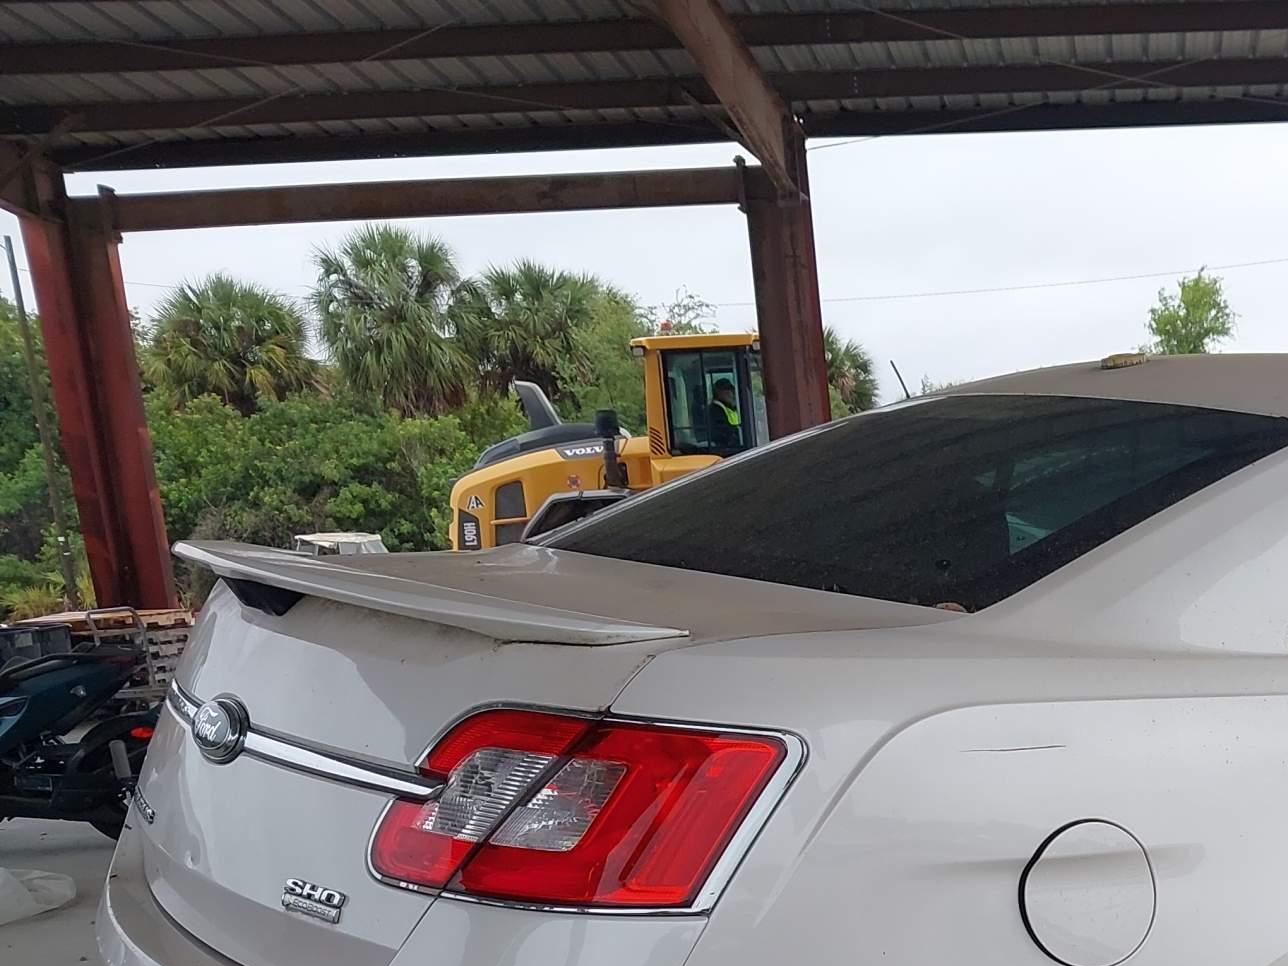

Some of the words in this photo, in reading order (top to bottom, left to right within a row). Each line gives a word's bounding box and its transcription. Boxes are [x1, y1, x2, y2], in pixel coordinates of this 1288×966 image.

[563, 445, 604, 456] VOLV
[464, 522, 478, 546] L90H
[197, 706, 222, 742] Ford
[284, 878, 346, 909] SHO
